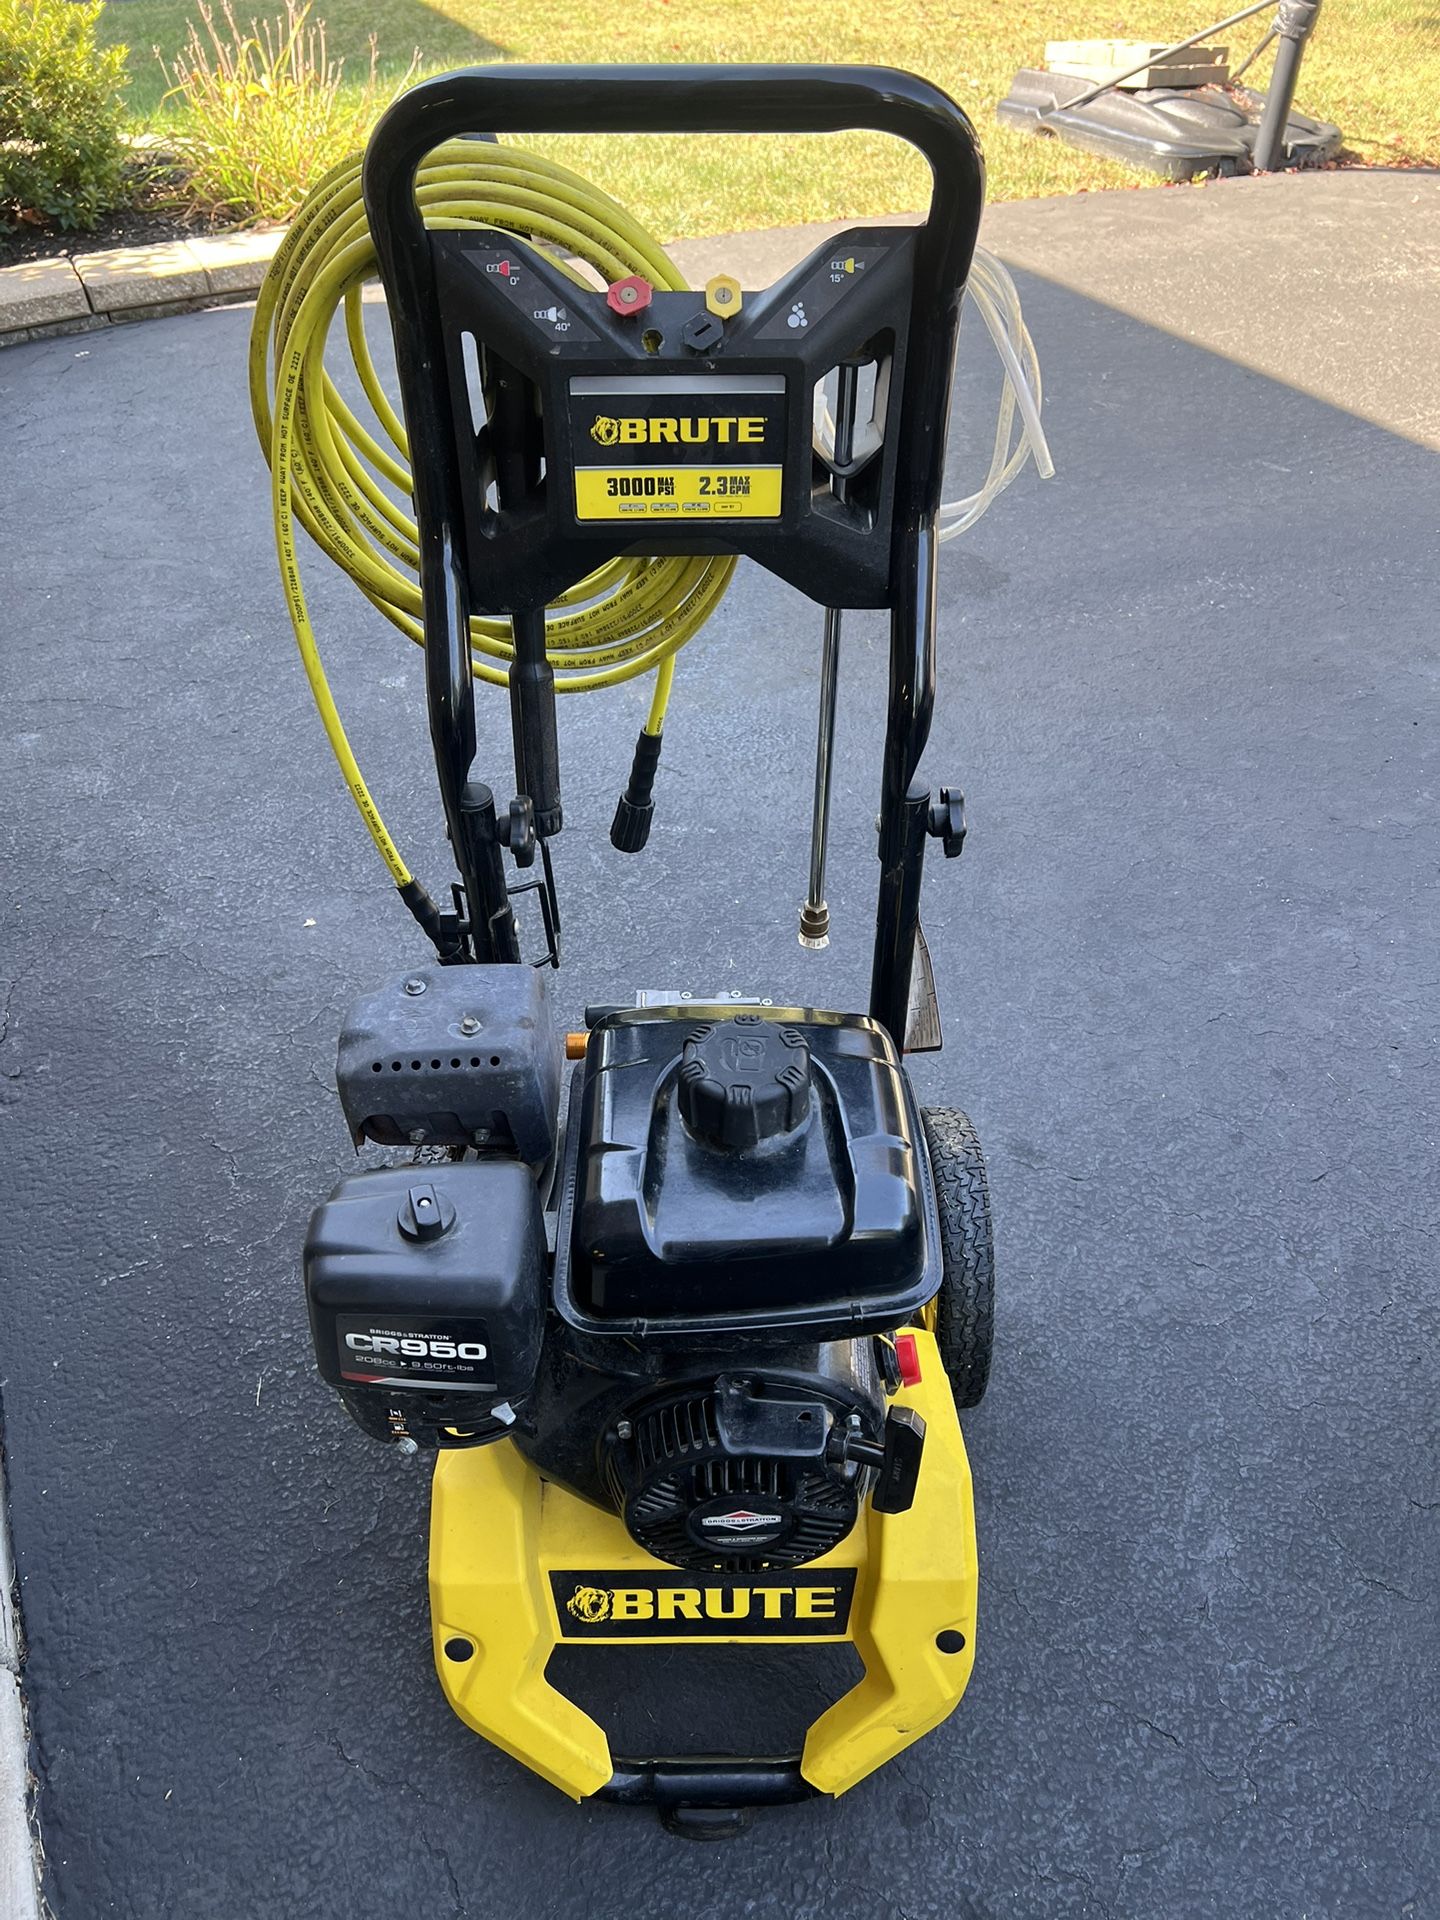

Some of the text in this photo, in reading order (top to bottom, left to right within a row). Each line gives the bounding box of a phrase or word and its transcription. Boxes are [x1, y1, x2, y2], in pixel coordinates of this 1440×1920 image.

[509, 276, 520, 286] 0°
[829, 273, 845, 283] 15°
[554, 322, 571, 332] 40°
[281, 387, 294, 421] SURFACE
[281, 424, 289, 440] HOT
[619, 417, 766, 443] BRUTE
[279, 444, 288, 463] FROM
[279, 467, 287, 485] AWAY
[606, 476, 676, 497] 3000 MAX PSI
[699, 476, 751, 496] 2.3 MAX GPM
[359, 512, 386, 541] SURFACE
[385, 540, 400, 553] HOT
[588, 611, 600, 620] HOT
[602, 601, 618, 613] FROM
[558, 615, 586, 628] SURFACE
[345, 1333, 488, 1360] CR950
[355, 1354, 397, 1366] 208cc
[609, 1587, 837, 1620] BRUTE
